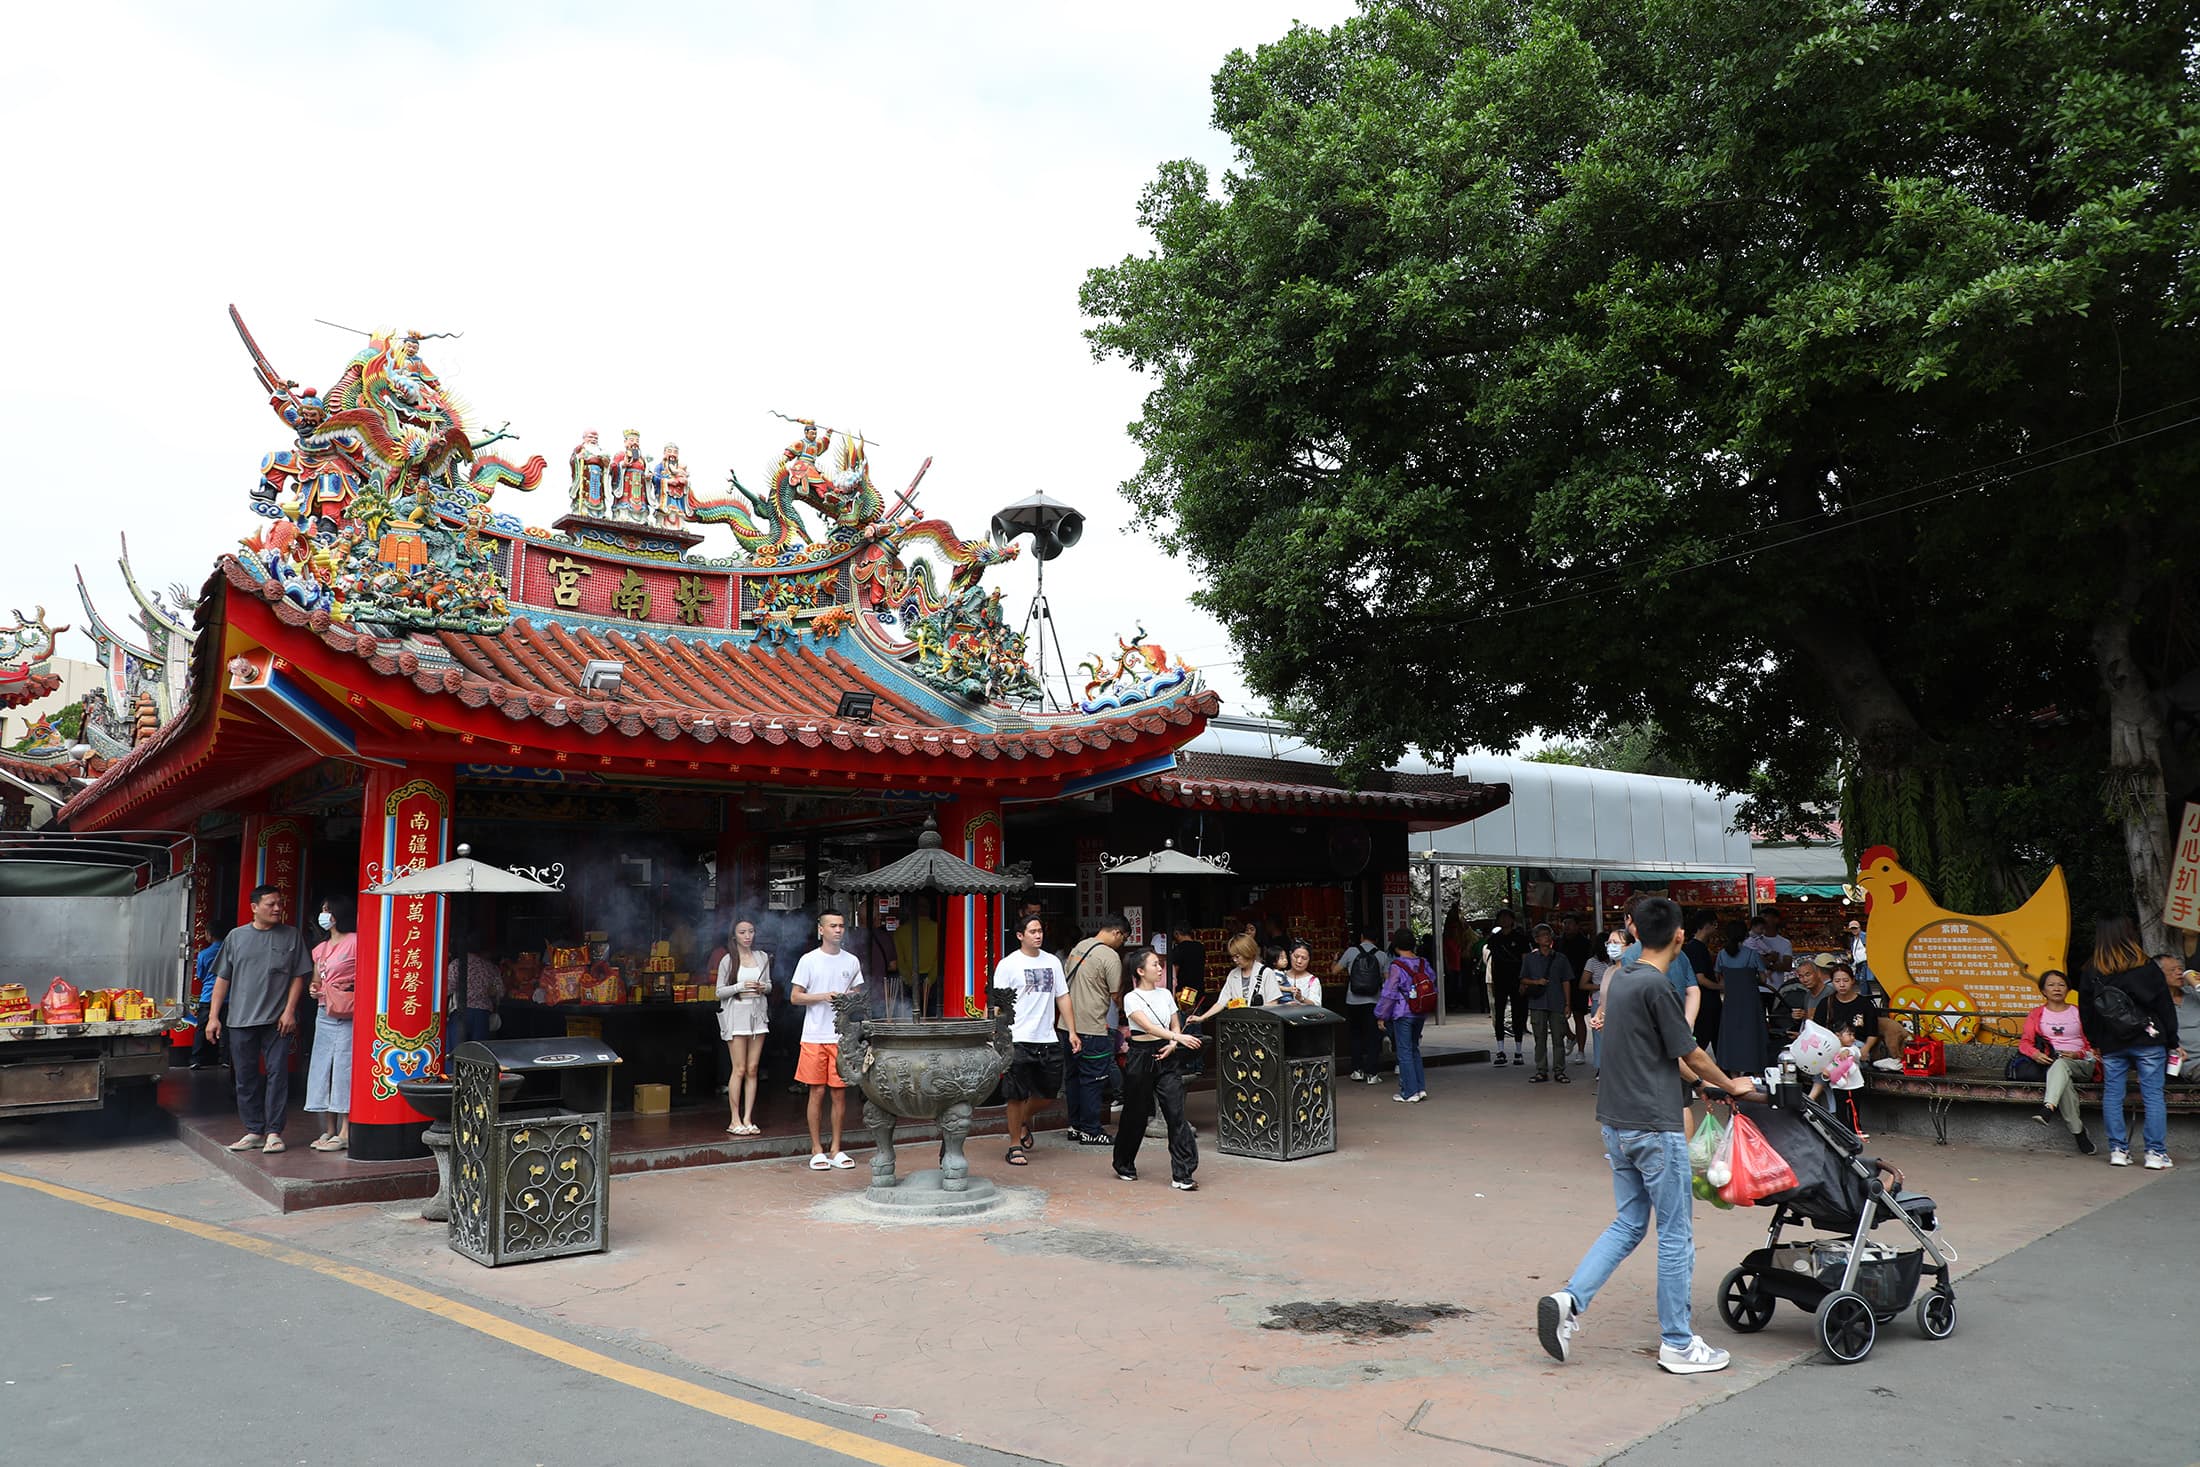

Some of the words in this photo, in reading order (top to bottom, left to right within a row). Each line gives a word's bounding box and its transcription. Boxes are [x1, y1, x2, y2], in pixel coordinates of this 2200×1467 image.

[547, 556, 714, 624] 紫南宮
[2171, 813, 2200, 922] 小心扒手
